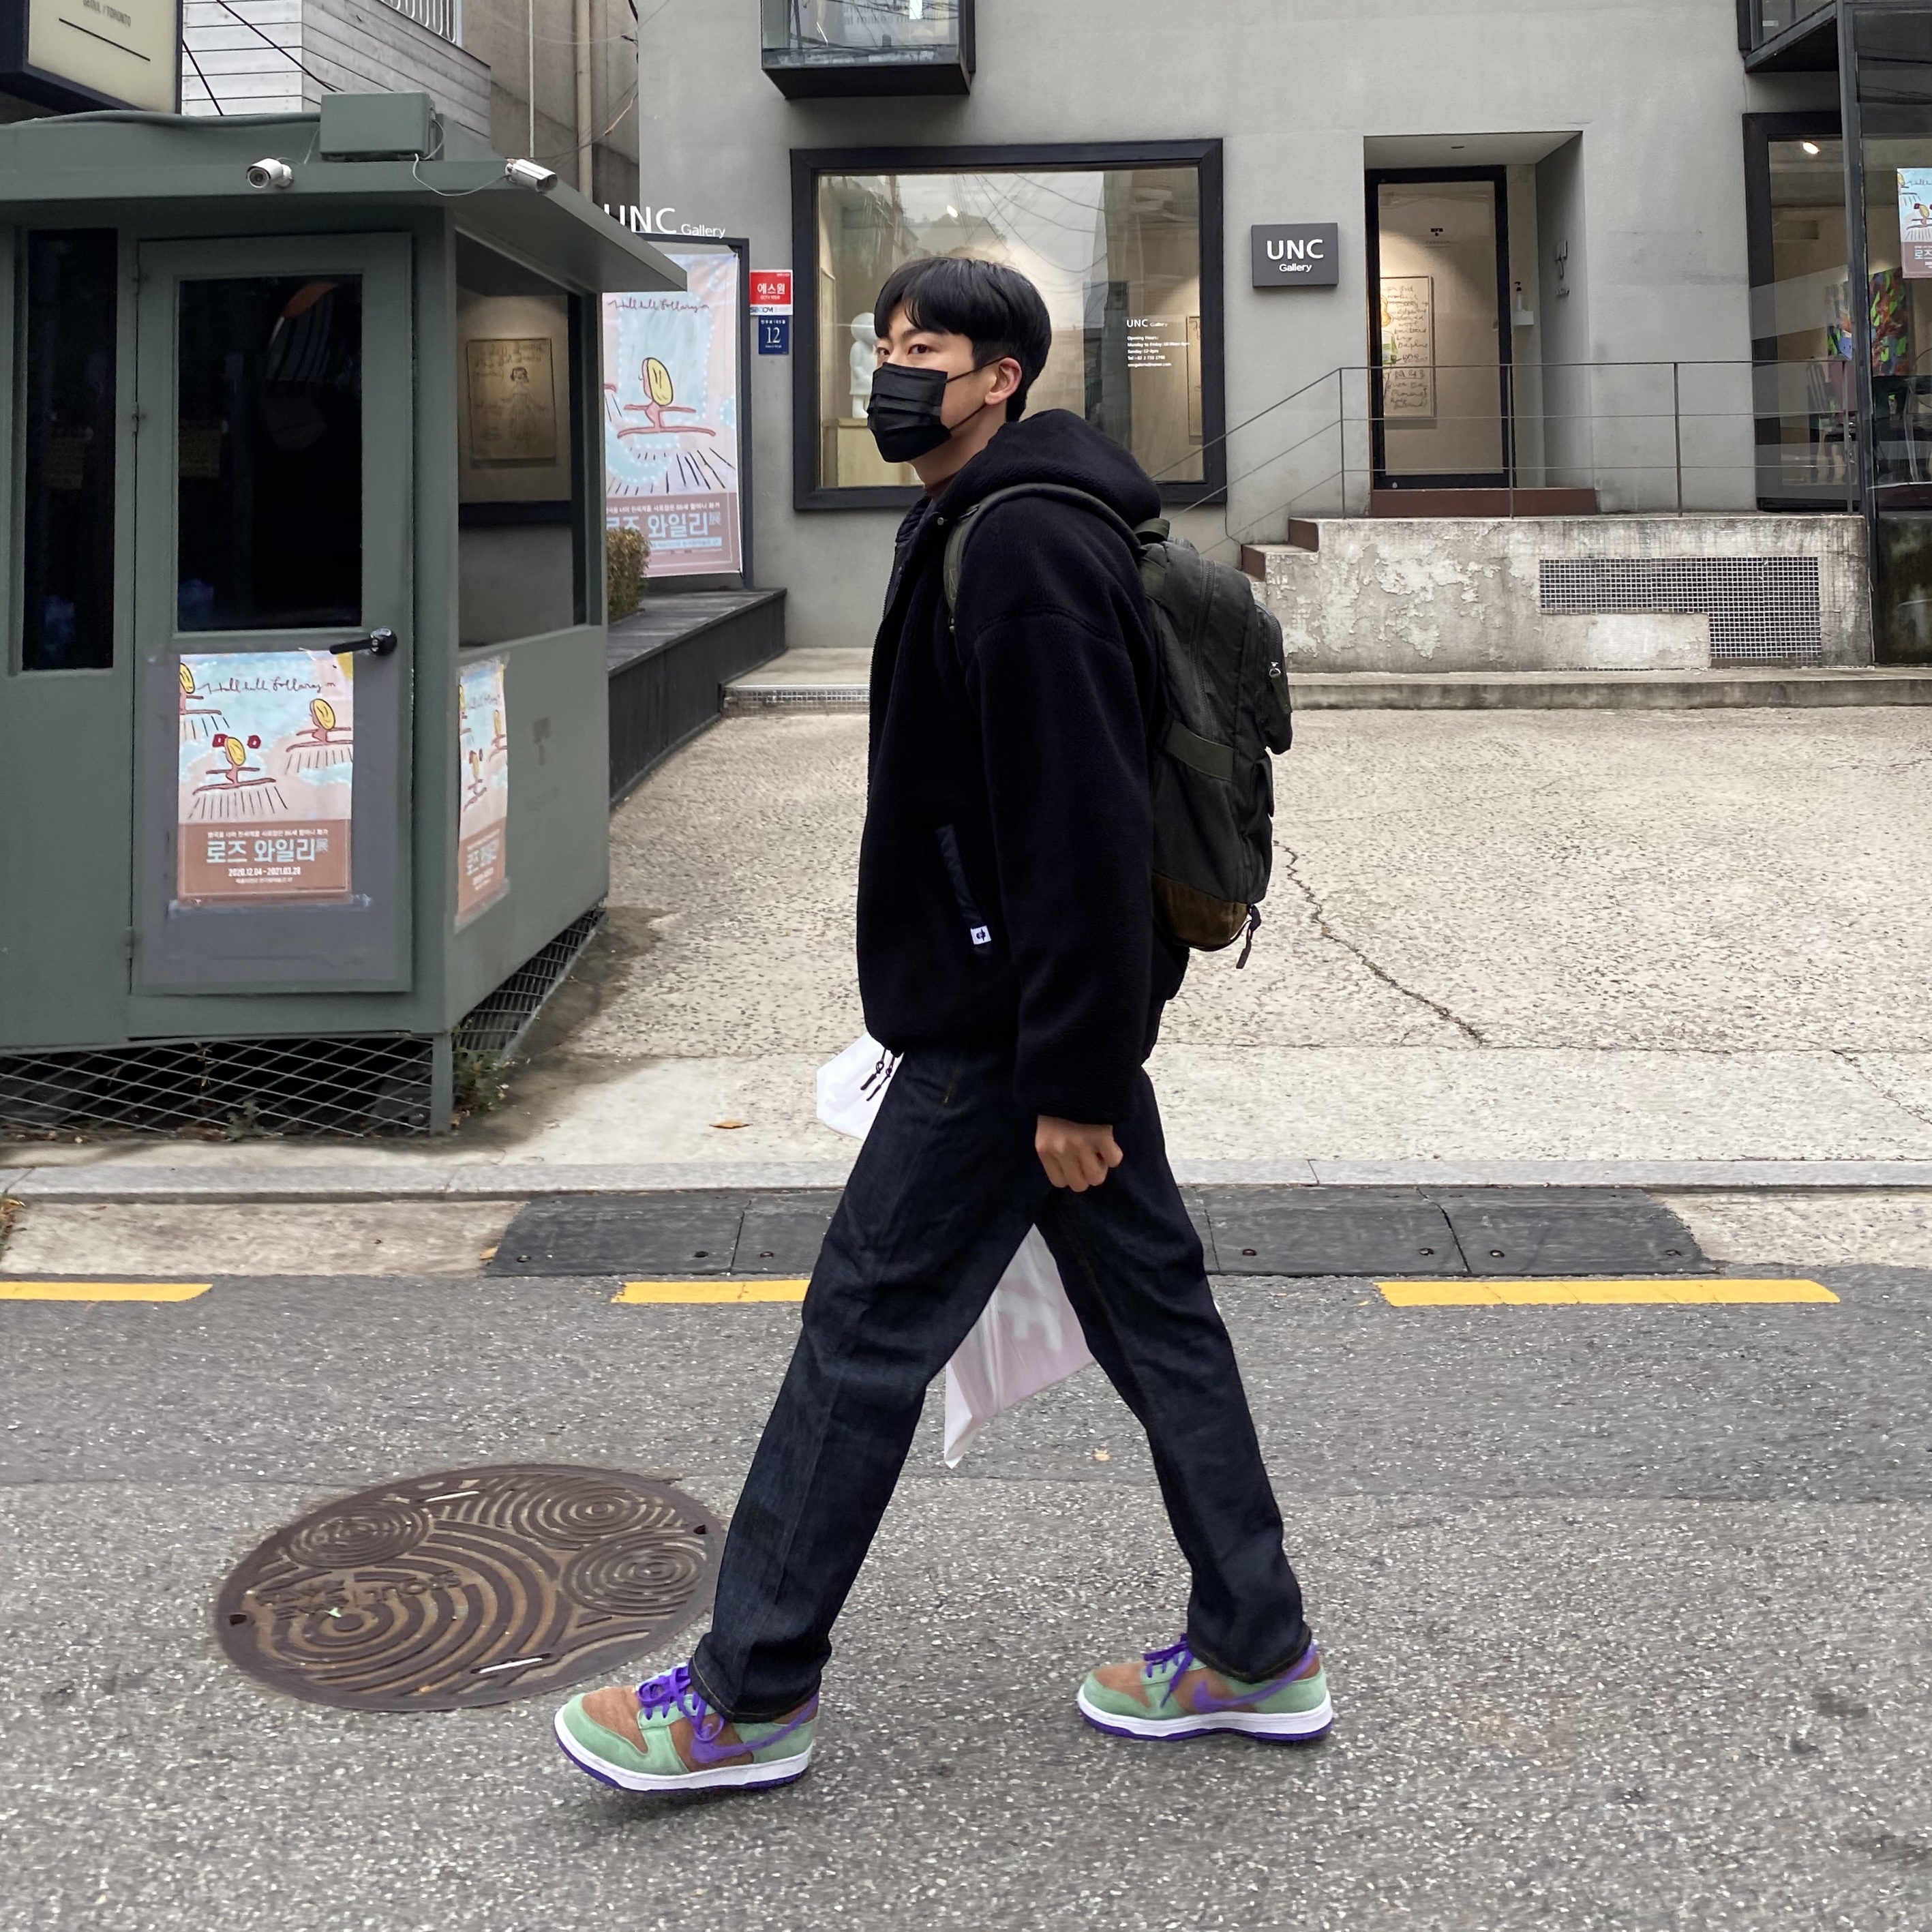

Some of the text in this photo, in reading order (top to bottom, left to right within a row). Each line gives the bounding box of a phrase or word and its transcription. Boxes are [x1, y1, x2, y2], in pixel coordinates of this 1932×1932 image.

[680, 224, 726, 239] Gallery
[1267, 239, 1324, 260] UNC
[1279, 263, 1312, 273] Gallery
[757, 283, 785, 295] 에스원
[1126, 319, 1148, 327] UNC
[766, 327, 781, 344] 12
[207, 840, 247, 863] 로즈
